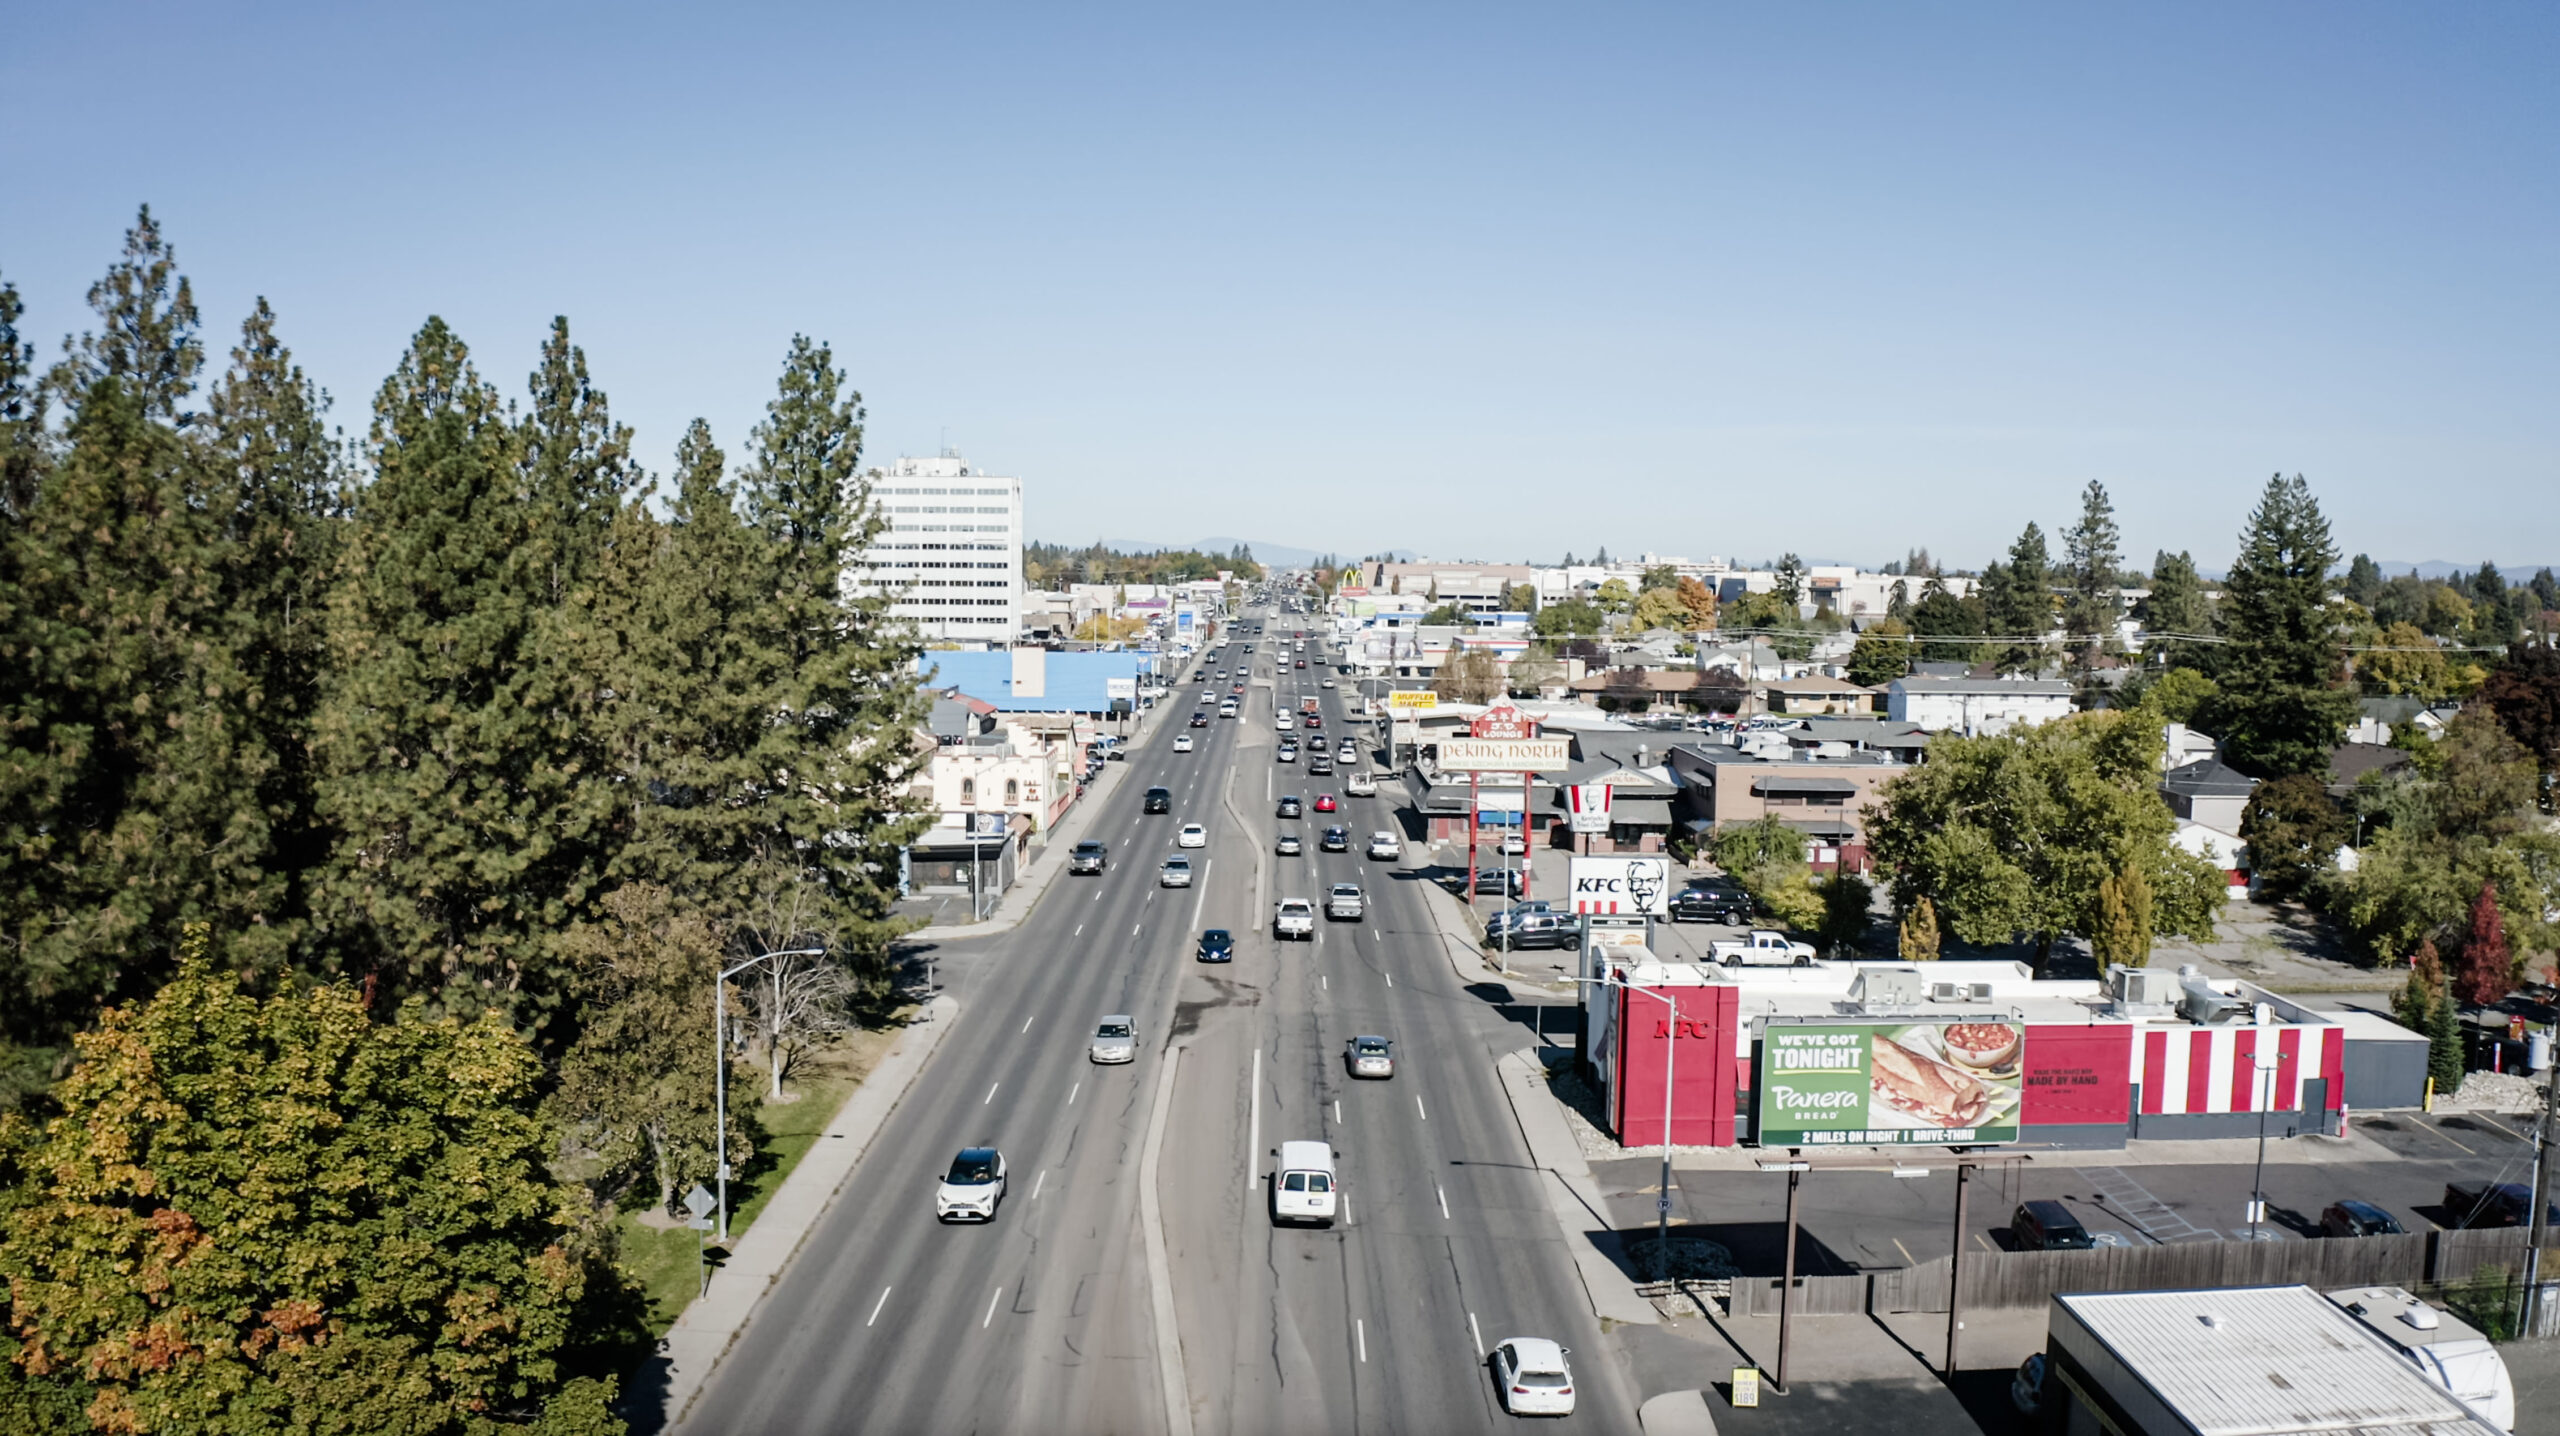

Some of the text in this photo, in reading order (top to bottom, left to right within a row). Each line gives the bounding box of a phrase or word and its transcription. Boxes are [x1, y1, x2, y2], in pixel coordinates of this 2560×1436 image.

[1483, 730, 1523, 738] LOUNGE
[1576, 878, 1621, 892] KFC
[1653, 1020, 1709, 1039] KFC
[1778, 1034, 1858, 1046] WE'VE GOT
[1772, 1048, 1862, 1069] TONIGHT
[2027, 1075, 2098, 1086] MADE BY HAND
[1771, 1086, 1858, 1110] Panera
[1795, 1111, 1838, 1120] BREAD
[1802, 1131, 1811, 1144] 2
[1812, 1131, 1847, 1143] MILES
[1848, 1131, 1865, 1143] ON
[1866, 1130, 1899, 1143] RIGHT
[1913, 1129, 1976, 1142] DRIVE-THRU
[1735, 1392, 1755, 1405] $189
